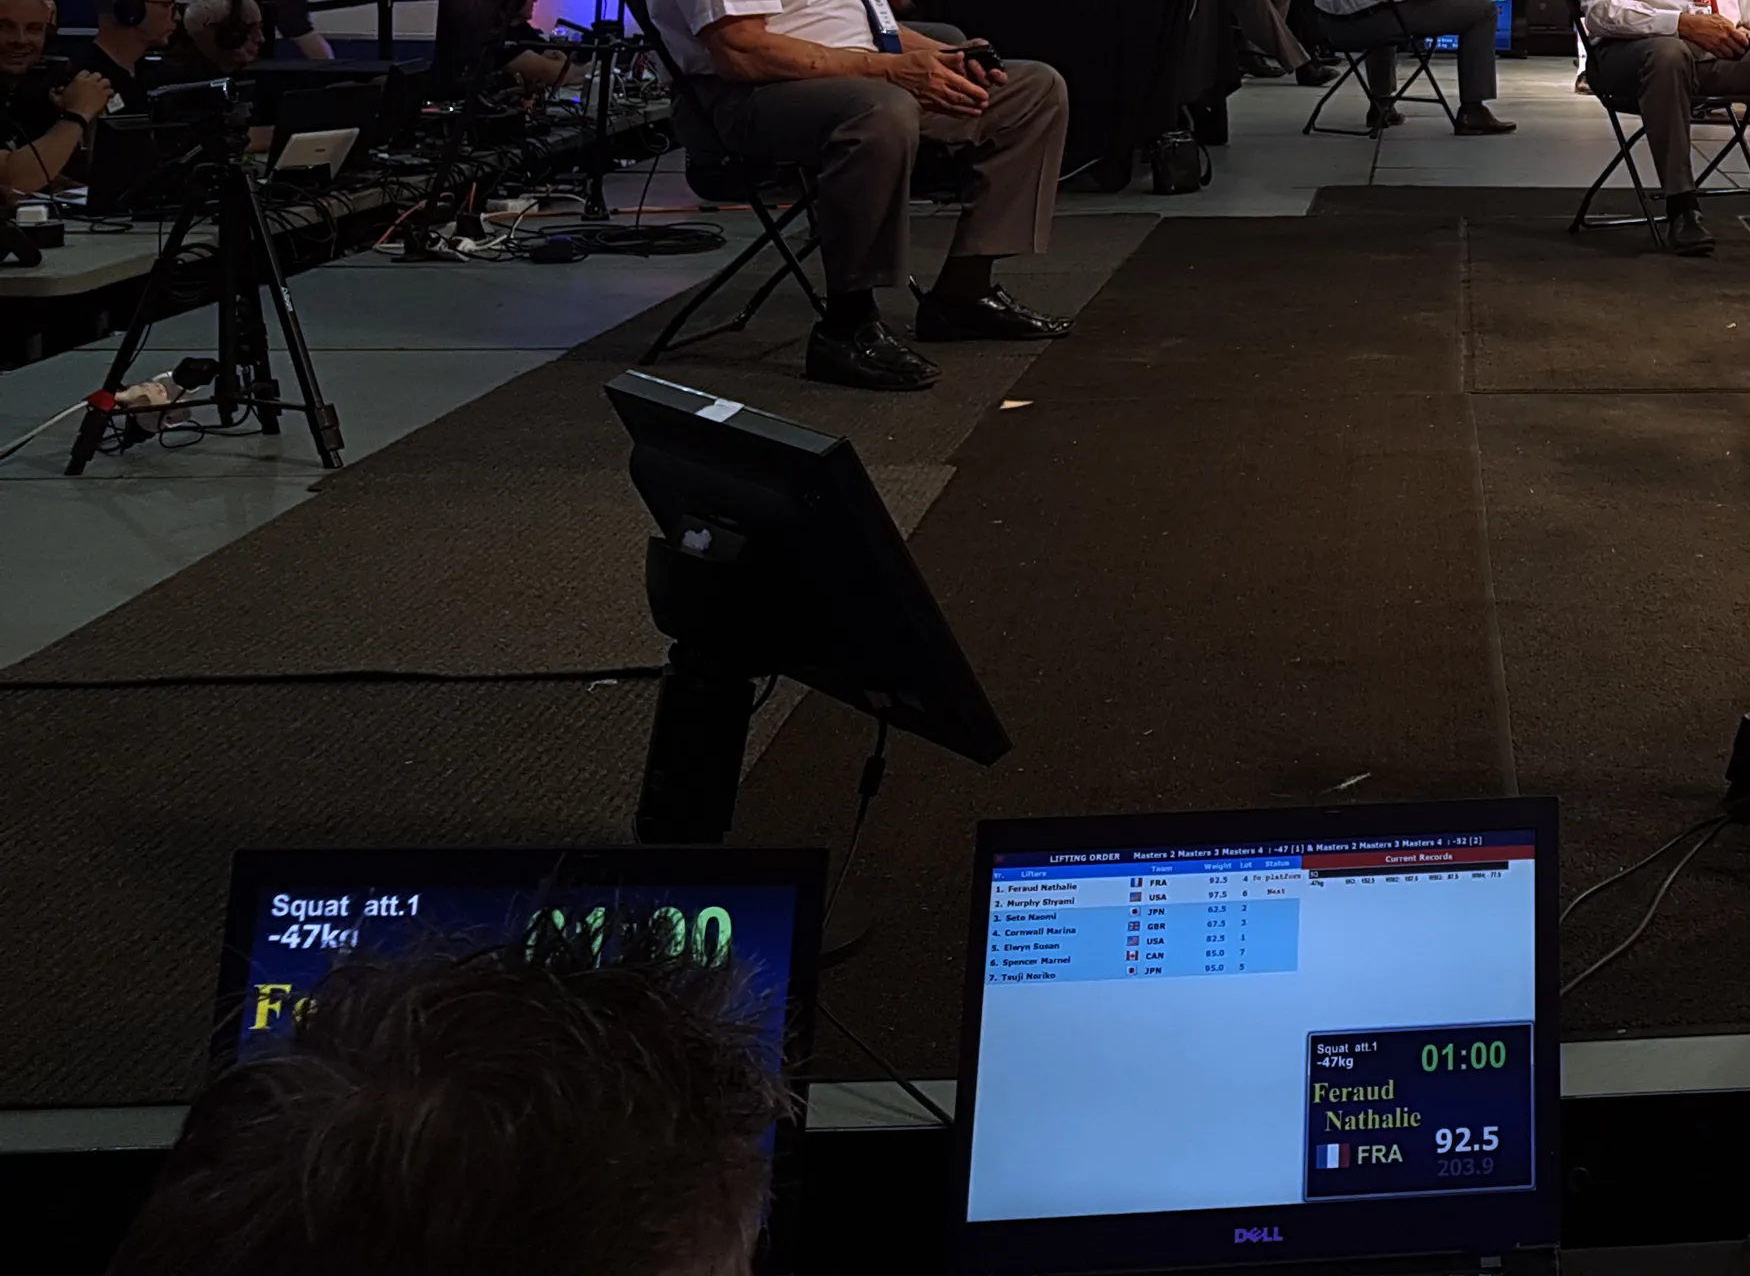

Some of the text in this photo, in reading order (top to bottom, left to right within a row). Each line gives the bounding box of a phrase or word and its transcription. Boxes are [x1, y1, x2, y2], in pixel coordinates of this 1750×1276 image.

[1050, 854, 1087, 863] LIFTING
[1089, 853, 1120, 861] ORDER
[1133, 850, 1168, 860] Masters
[1178, 849, 1212, 858] Masters
[1222, 847, 1256, 856] Masters
[1316, 843, 1349, 852] Masters
[1359, 841, 1392, 849] Masters
[1402, 839, 1436, 847] Masters
[1385, 852, 1453, 863] Current Records
[1151, 865, 1173, 873] Team
[1204, 862, 1232, 871] Weight
[1240, 861, 1252, 869] Lot
[1265, 860, 1290, 868] Status
[1008, 884, 1039, 893] Feraud
[1041, 883, 1077, 892] Nathalie
[1149, 879, 1168, 887] FRA
[1209, 876, 1228, 884] 92.5
[271, 893, 421, 922] Squat att.1
[1007, 898, 1040, 907] Murphy
[1148, 893, 1167, 901] USA
[1208, 891, 1228, 899] 97.5
[1005, 914, 1026, 922] Seto
[1028, 912, 1057, 921] Naomi
[1147, 908, 1165, 916] JPN
[1004, 927, 1044, 937] Cornwall
[1046, 926, 1077, 936] Marina
[1147, 922, 1166, 931] GBR
[991, 943, 1000, 952] 5.
[1003, 942, 1031, 953] Elwyn
[1033, 942, 1061, 951] Susan
[1146, 937, 1165, 946] USA
[1206, 934, 1225, 943] 82.5
[989, 958, 999, 966] 6.
[1002, 957, 1038, 968] Spencer
[1145, 952, 1164, 960] CAN
[988, 973, 998, 982] 7.
[1001, 972, 1025, 983] Tsuji
[1027, 971, 1056, 981] Noriko
[1144, 966, 1163, 975] JPN
[1205, 964, 1224, 973] 95.0
[1317, 1041, 1378, 1055] Squat att.1
[1421, 1040, 1507, 1072] 01:00
[1317, 1055, 1354, 1069] -47kg
[1313, 1079, 1395, 1103] Feraud
[1324, 1107, 1422, 1132] Nathalie
[1435, 1126, 1499, 1154] 92.5
[1356, 1144, 1403, 1165] FRA
[1437, 1157, 1494, 1177] 203.9
[1233, 1226, 1284, 1244] DELL
